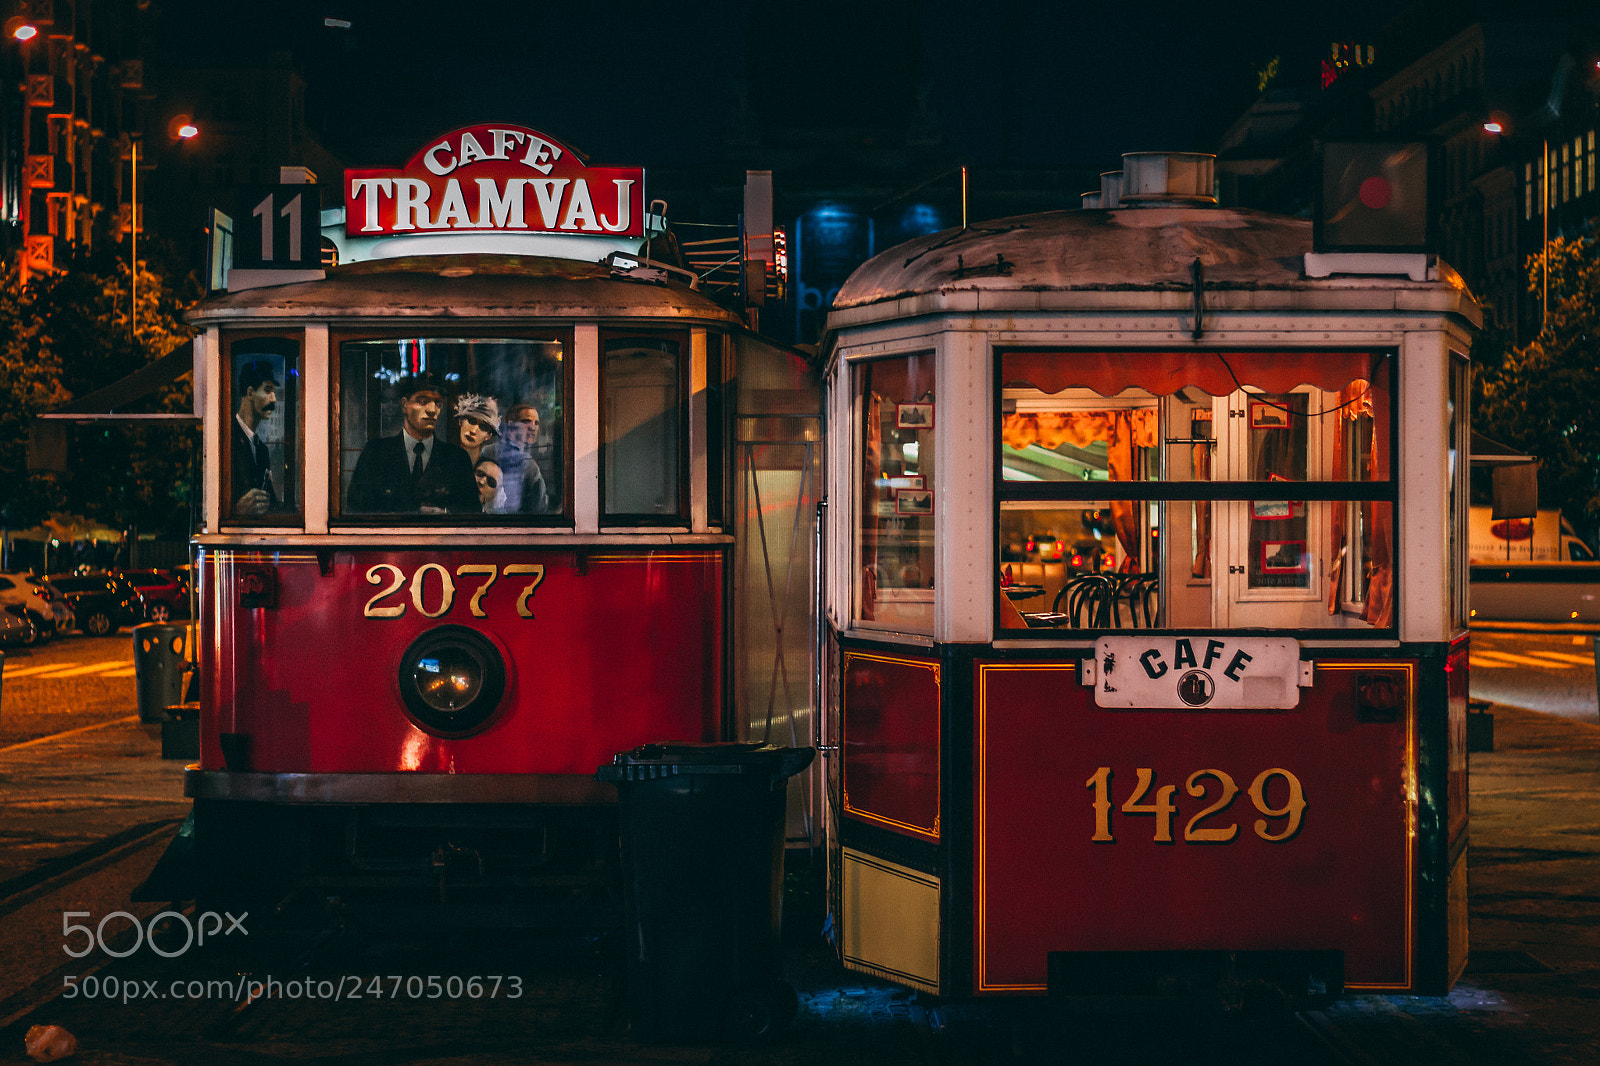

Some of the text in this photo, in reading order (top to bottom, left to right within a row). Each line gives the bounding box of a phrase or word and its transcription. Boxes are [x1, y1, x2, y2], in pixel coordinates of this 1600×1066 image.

[424, 129, 563, 176] CAFE
[252, 192, 302, 262] 11
[352, 178, 635, 232] TRAMVAJ
[364, 563, 547, 619] 2077
[1139, 638, 1253, 683] CAFE
[1086, 766, 1310, 845] 1429
